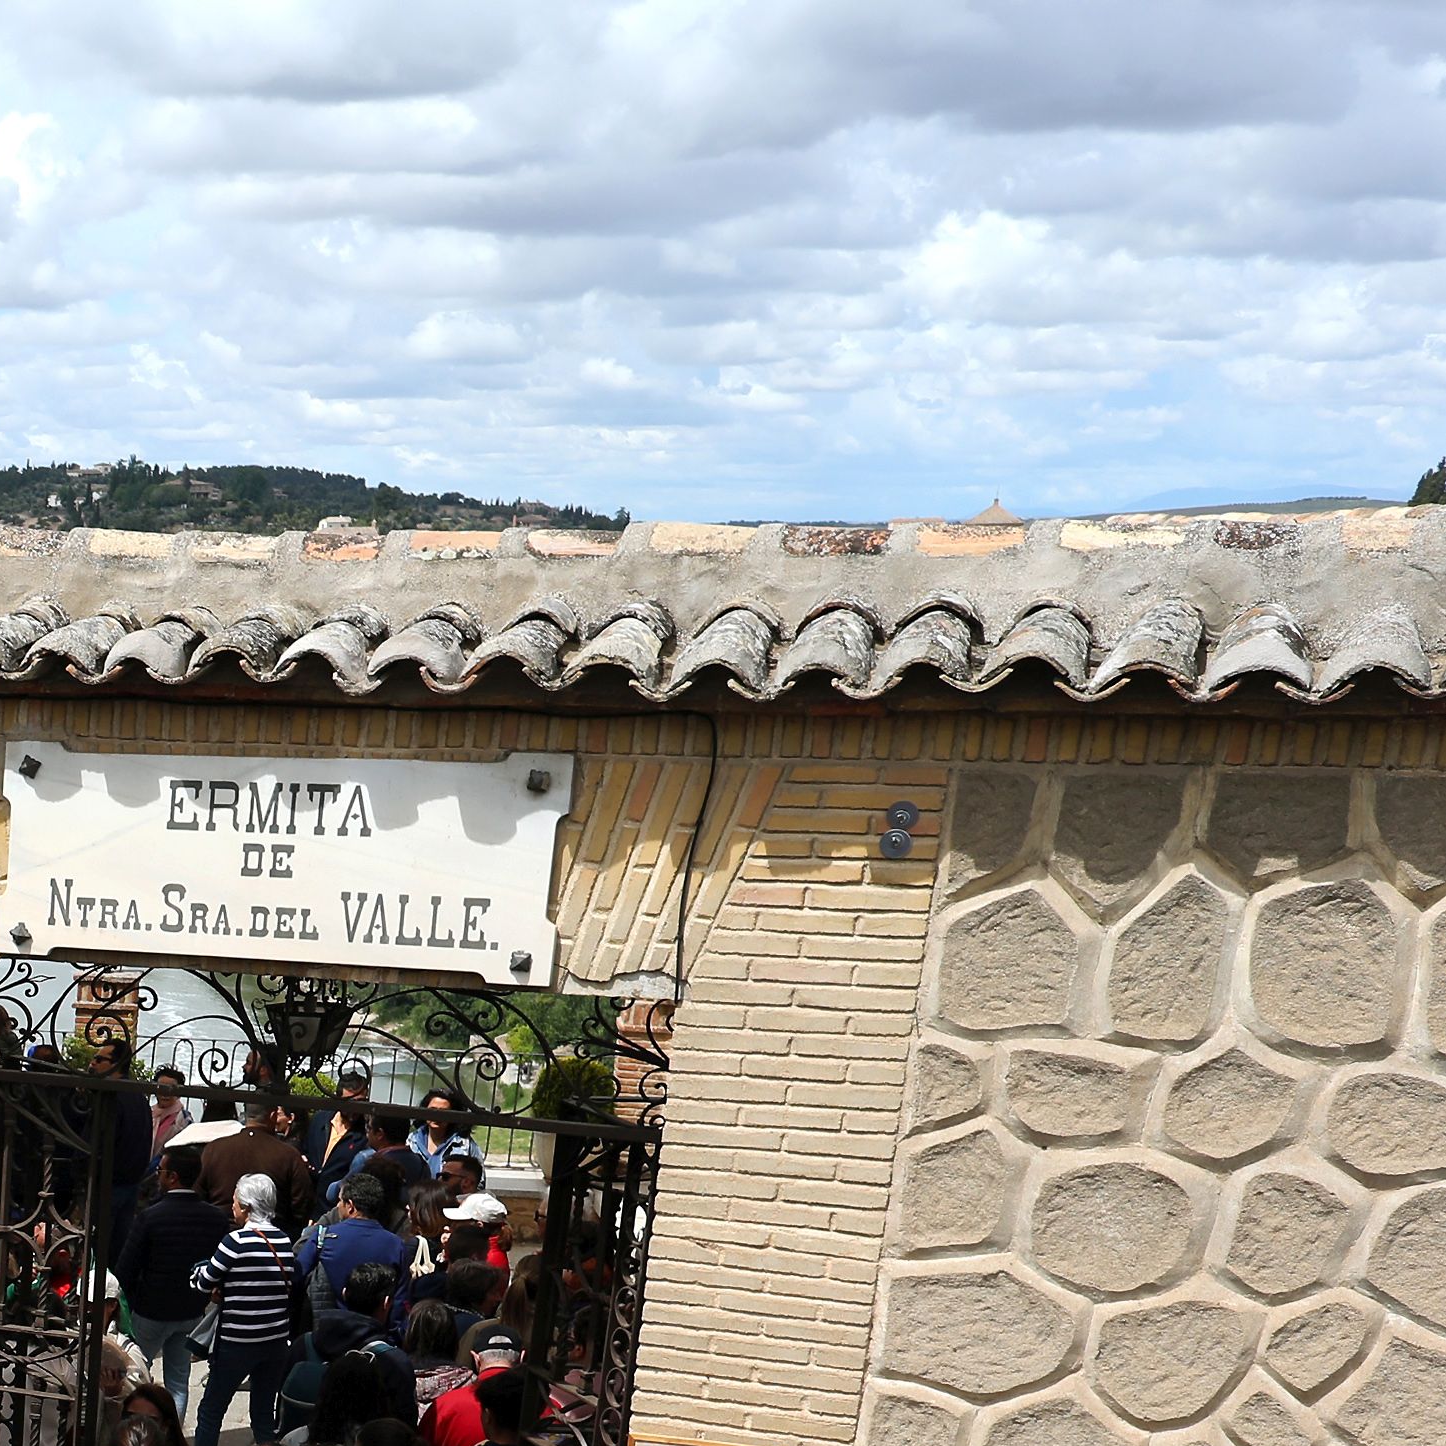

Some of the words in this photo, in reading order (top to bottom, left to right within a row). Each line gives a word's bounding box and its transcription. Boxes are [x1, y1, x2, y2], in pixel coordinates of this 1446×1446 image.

[166, 780, 372, 837] ERMITA
[240, 843, 295, 878] DE
[340, 891, 499, 951] VALLE.
